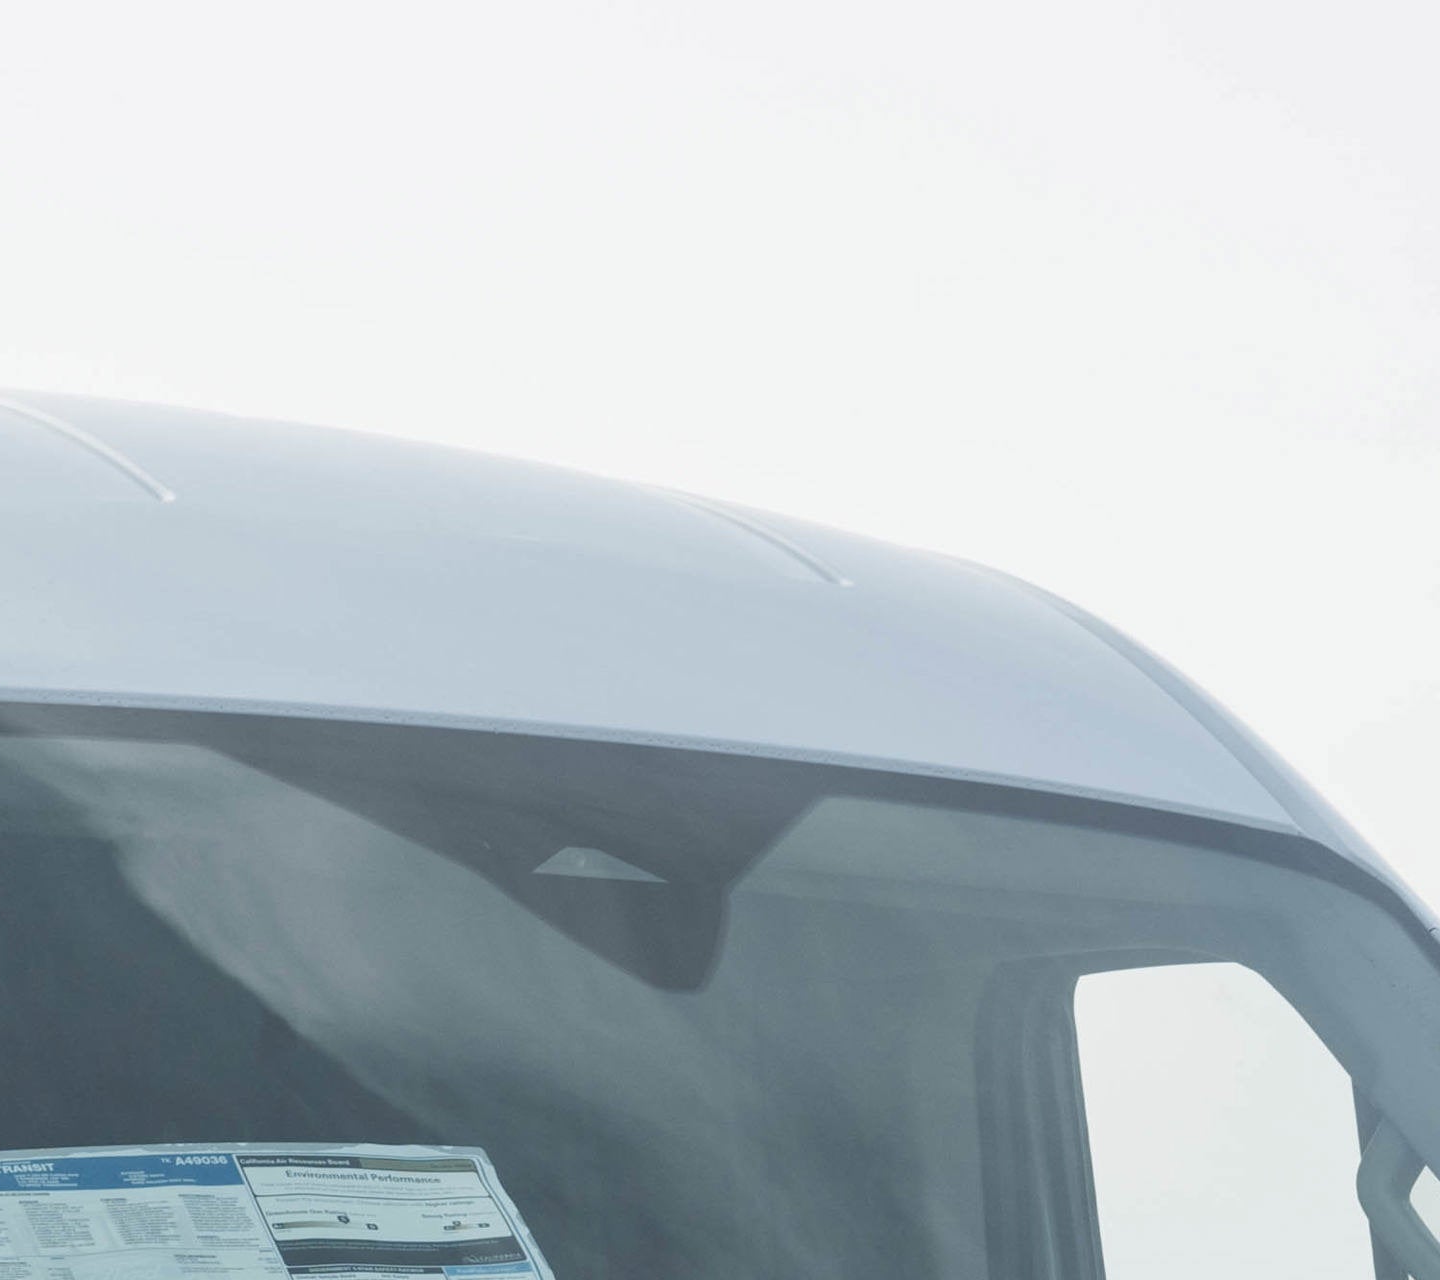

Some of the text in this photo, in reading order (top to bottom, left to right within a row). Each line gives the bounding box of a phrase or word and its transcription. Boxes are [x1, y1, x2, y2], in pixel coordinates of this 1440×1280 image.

[175, 1156, 228, 1166] A49036
[240, 1158, 275, 1166] California
[285, 1170, 441, 1184] Environmental Performance
